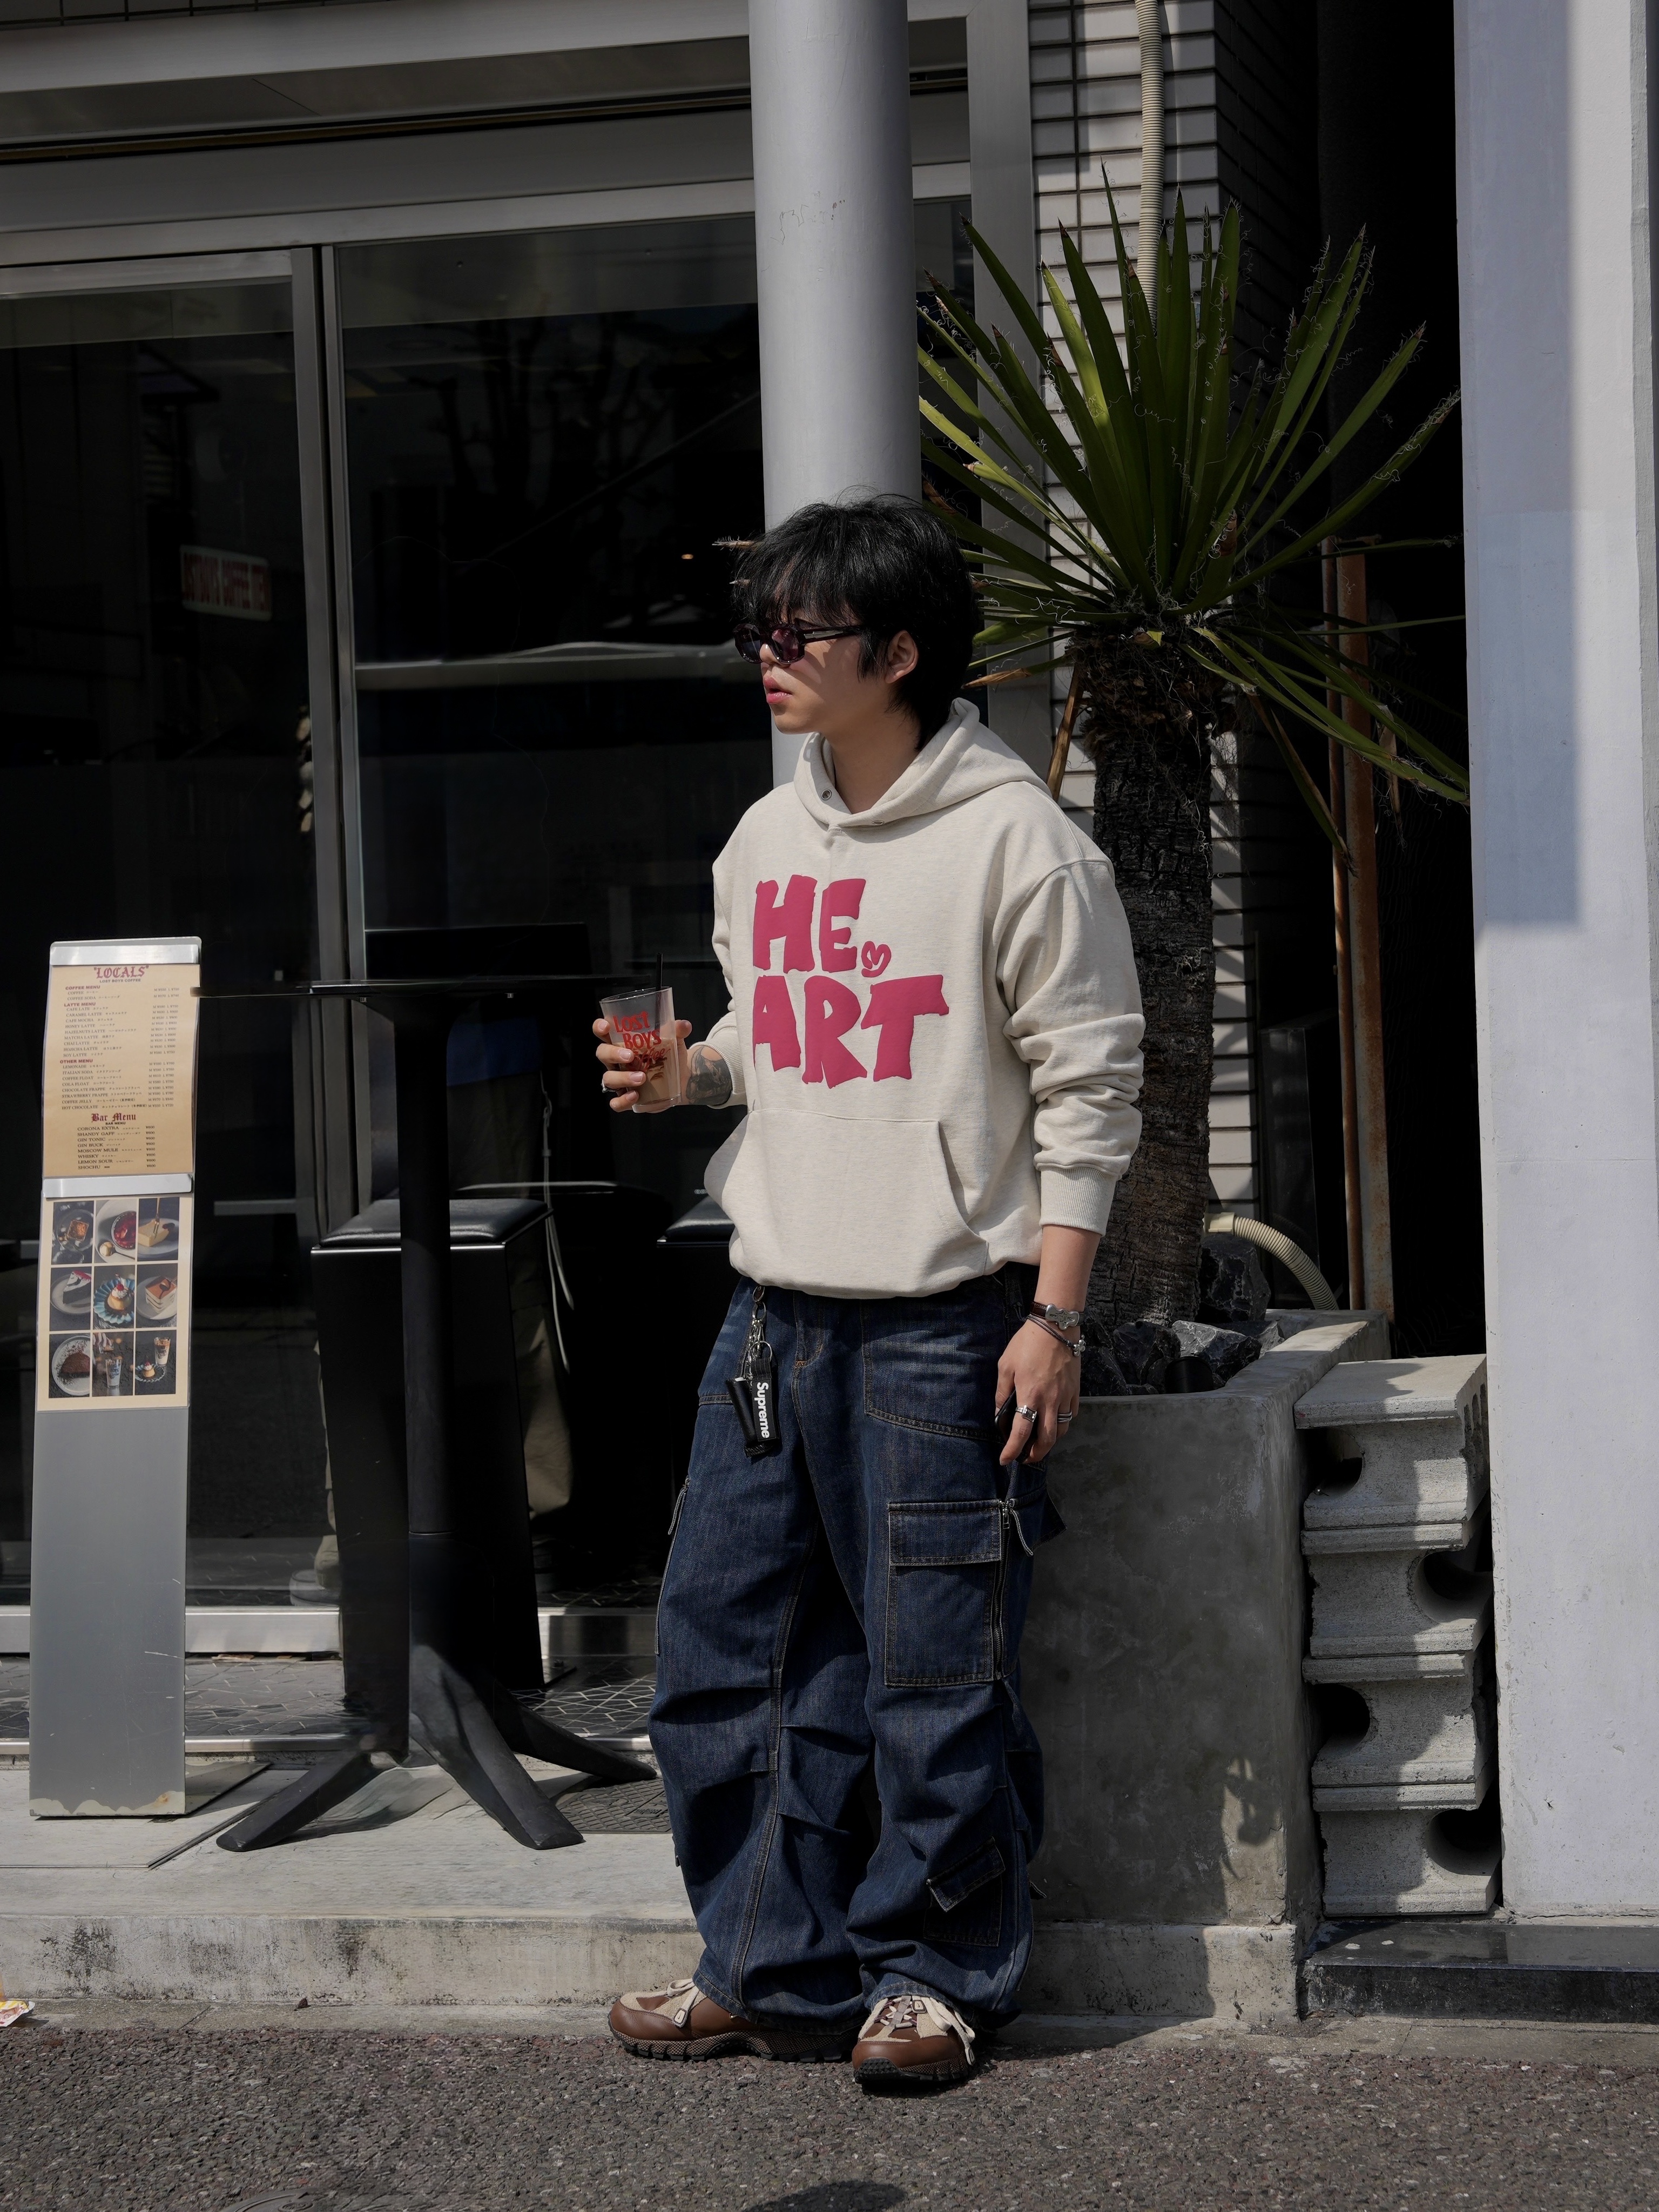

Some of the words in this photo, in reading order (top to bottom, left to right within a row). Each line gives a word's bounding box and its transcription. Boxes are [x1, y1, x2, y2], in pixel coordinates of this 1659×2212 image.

[753, 875, 866, 973] HE
[613, 1011, 650, 1033] LOST
[623, 1029, 662, 1050] BOYS
[752, 974, 949, 1089] ART
[91, 1113, 107, 1122] Bar
[112, 1113, 136, 1121] Menu
[754, 1382, 770, 1438] Supreme
